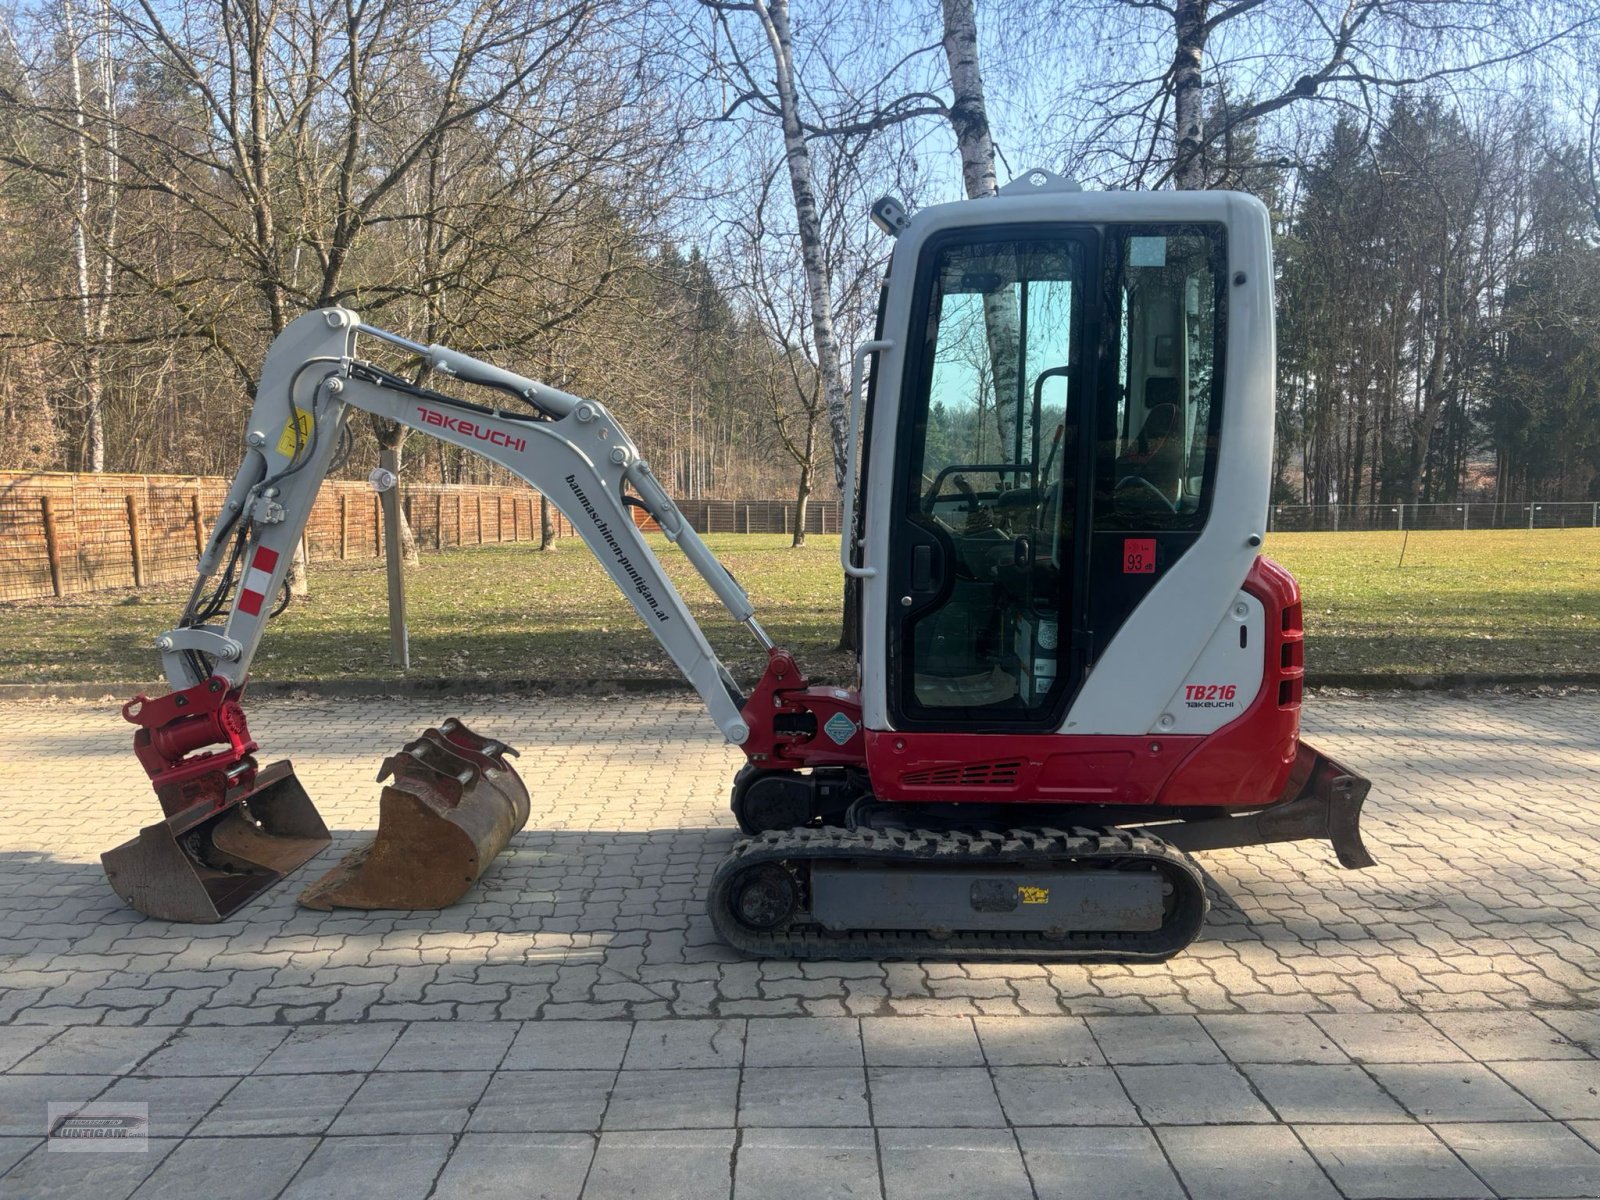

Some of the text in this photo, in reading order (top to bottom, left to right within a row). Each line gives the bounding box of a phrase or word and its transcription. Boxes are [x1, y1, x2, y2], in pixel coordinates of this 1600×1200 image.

[416, 406, 527, 453] TAKEUCHI
[564, 474, 671, 623] baumaschinen-puntigam.at
[1127, 553, 1143, 571] 93
[1185, 684, 1237, 701] TB216
